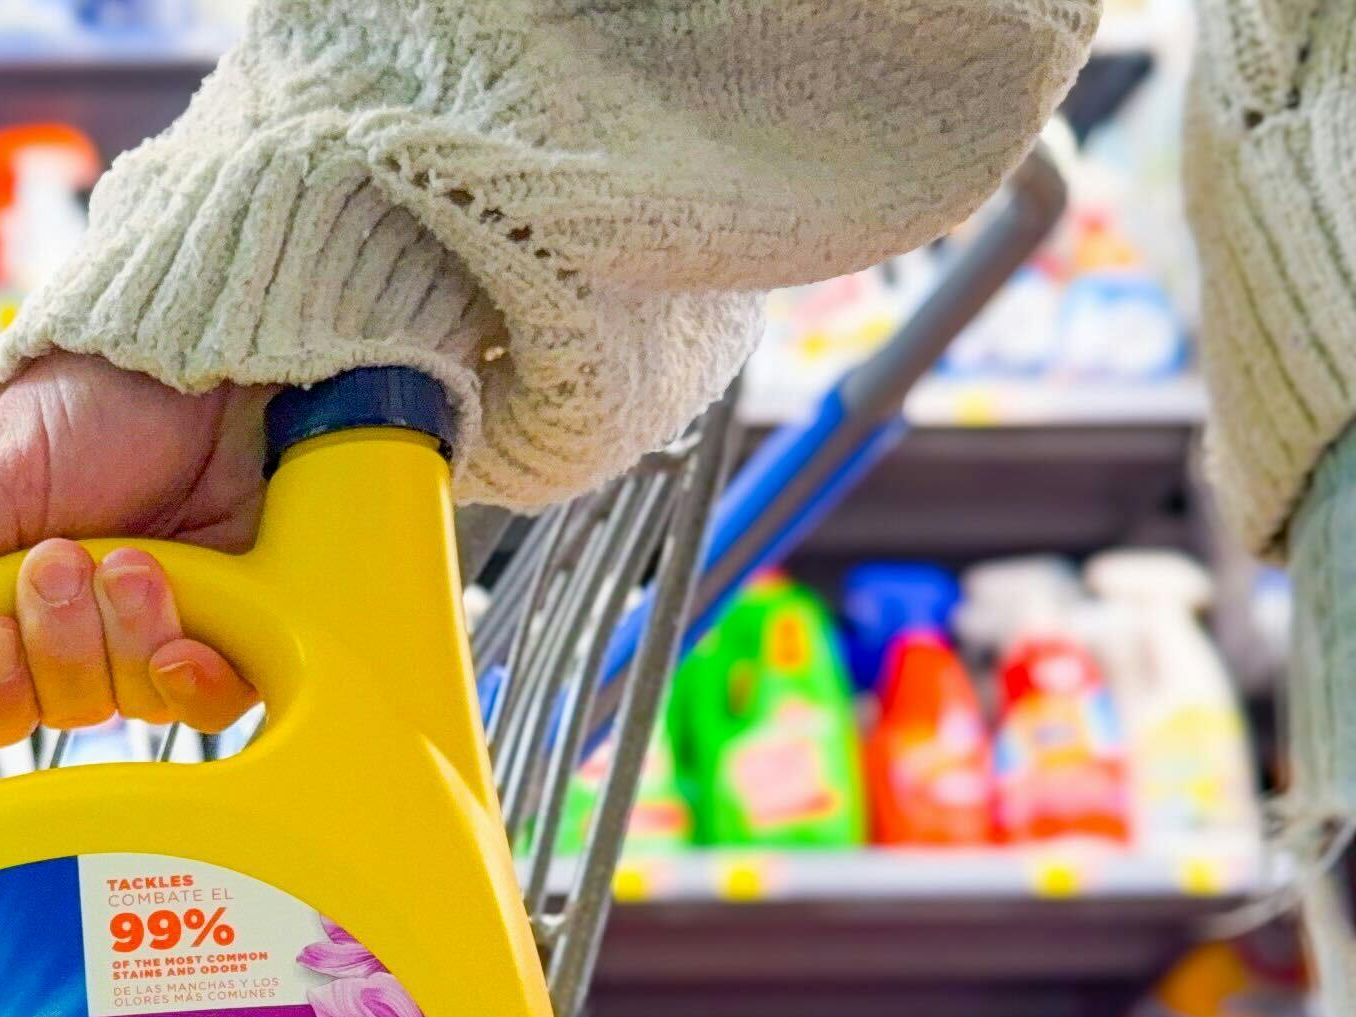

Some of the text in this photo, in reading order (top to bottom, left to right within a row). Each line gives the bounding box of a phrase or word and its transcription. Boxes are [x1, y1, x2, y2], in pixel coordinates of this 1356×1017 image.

[107, 875, 194, 891] TACKLES
[108, 888, 234, 907] COMBATE EL
[109, 907, 235, 953] 99%
[112, 952, 269, 970] OF THE MOST COMMON
[112, 964, 248, 980] STAINS AND ODORS
[114, 977, 280, 997] DE LAS MANCHAS Y LOS
[114, 995, 170, 1007] OLORES
[208, 988, 276, 1001] COMUNES
